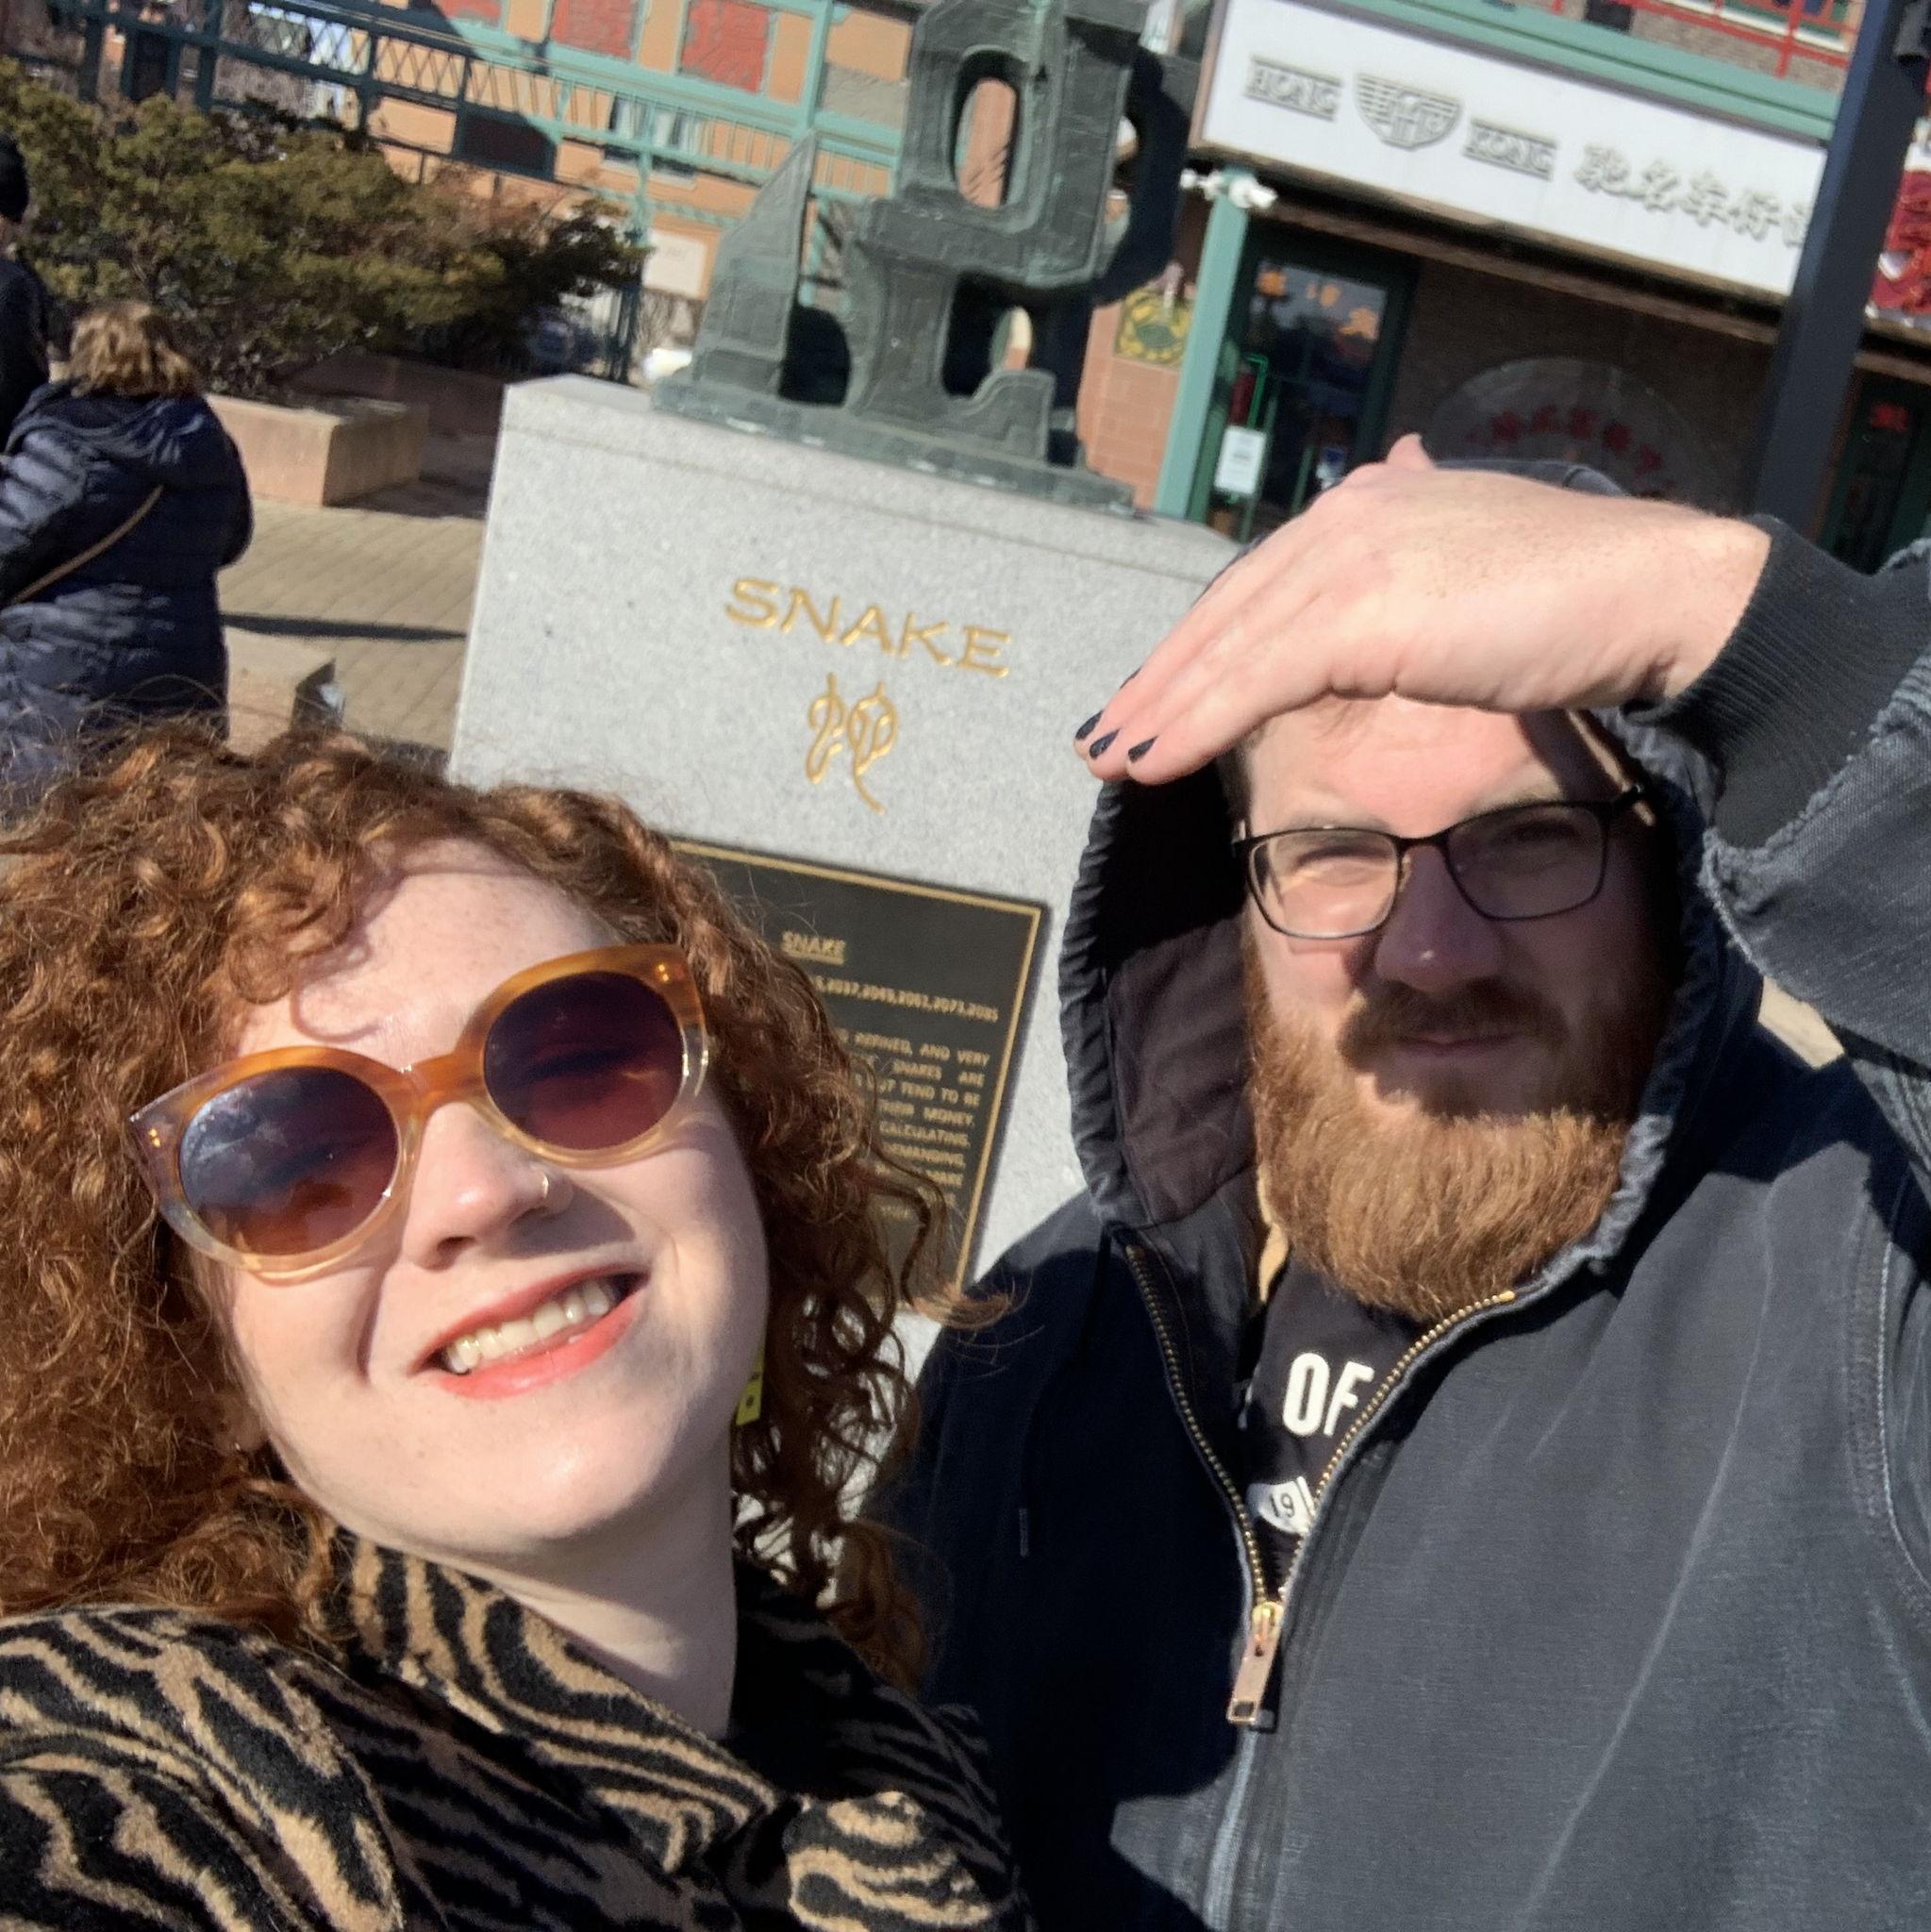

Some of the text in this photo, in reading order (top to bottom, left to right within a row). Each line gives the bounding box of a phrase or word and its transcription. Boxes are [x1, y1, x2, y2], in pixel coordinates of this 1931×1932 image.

[1247, 62, 1340, 117] HONG
[1468, 125, 1556, 177] KONG
[725, 576, 1012, 677] SNAKE
[782, 930, 846, 959] SNAKE
[919, 1042, 951, 1061] AND
[957, 1049, 990, 1067] VERY
[957, 1071, 986, 1088] ARE
[901, 1081, 936, 1101] TEND
[941, 1087, 959, 1105] TO
[963, 1092, 981, 1108] BE
[1282, 1352, 1375, 1438] OF
[1268, 1492, 1295, 1517] 19
